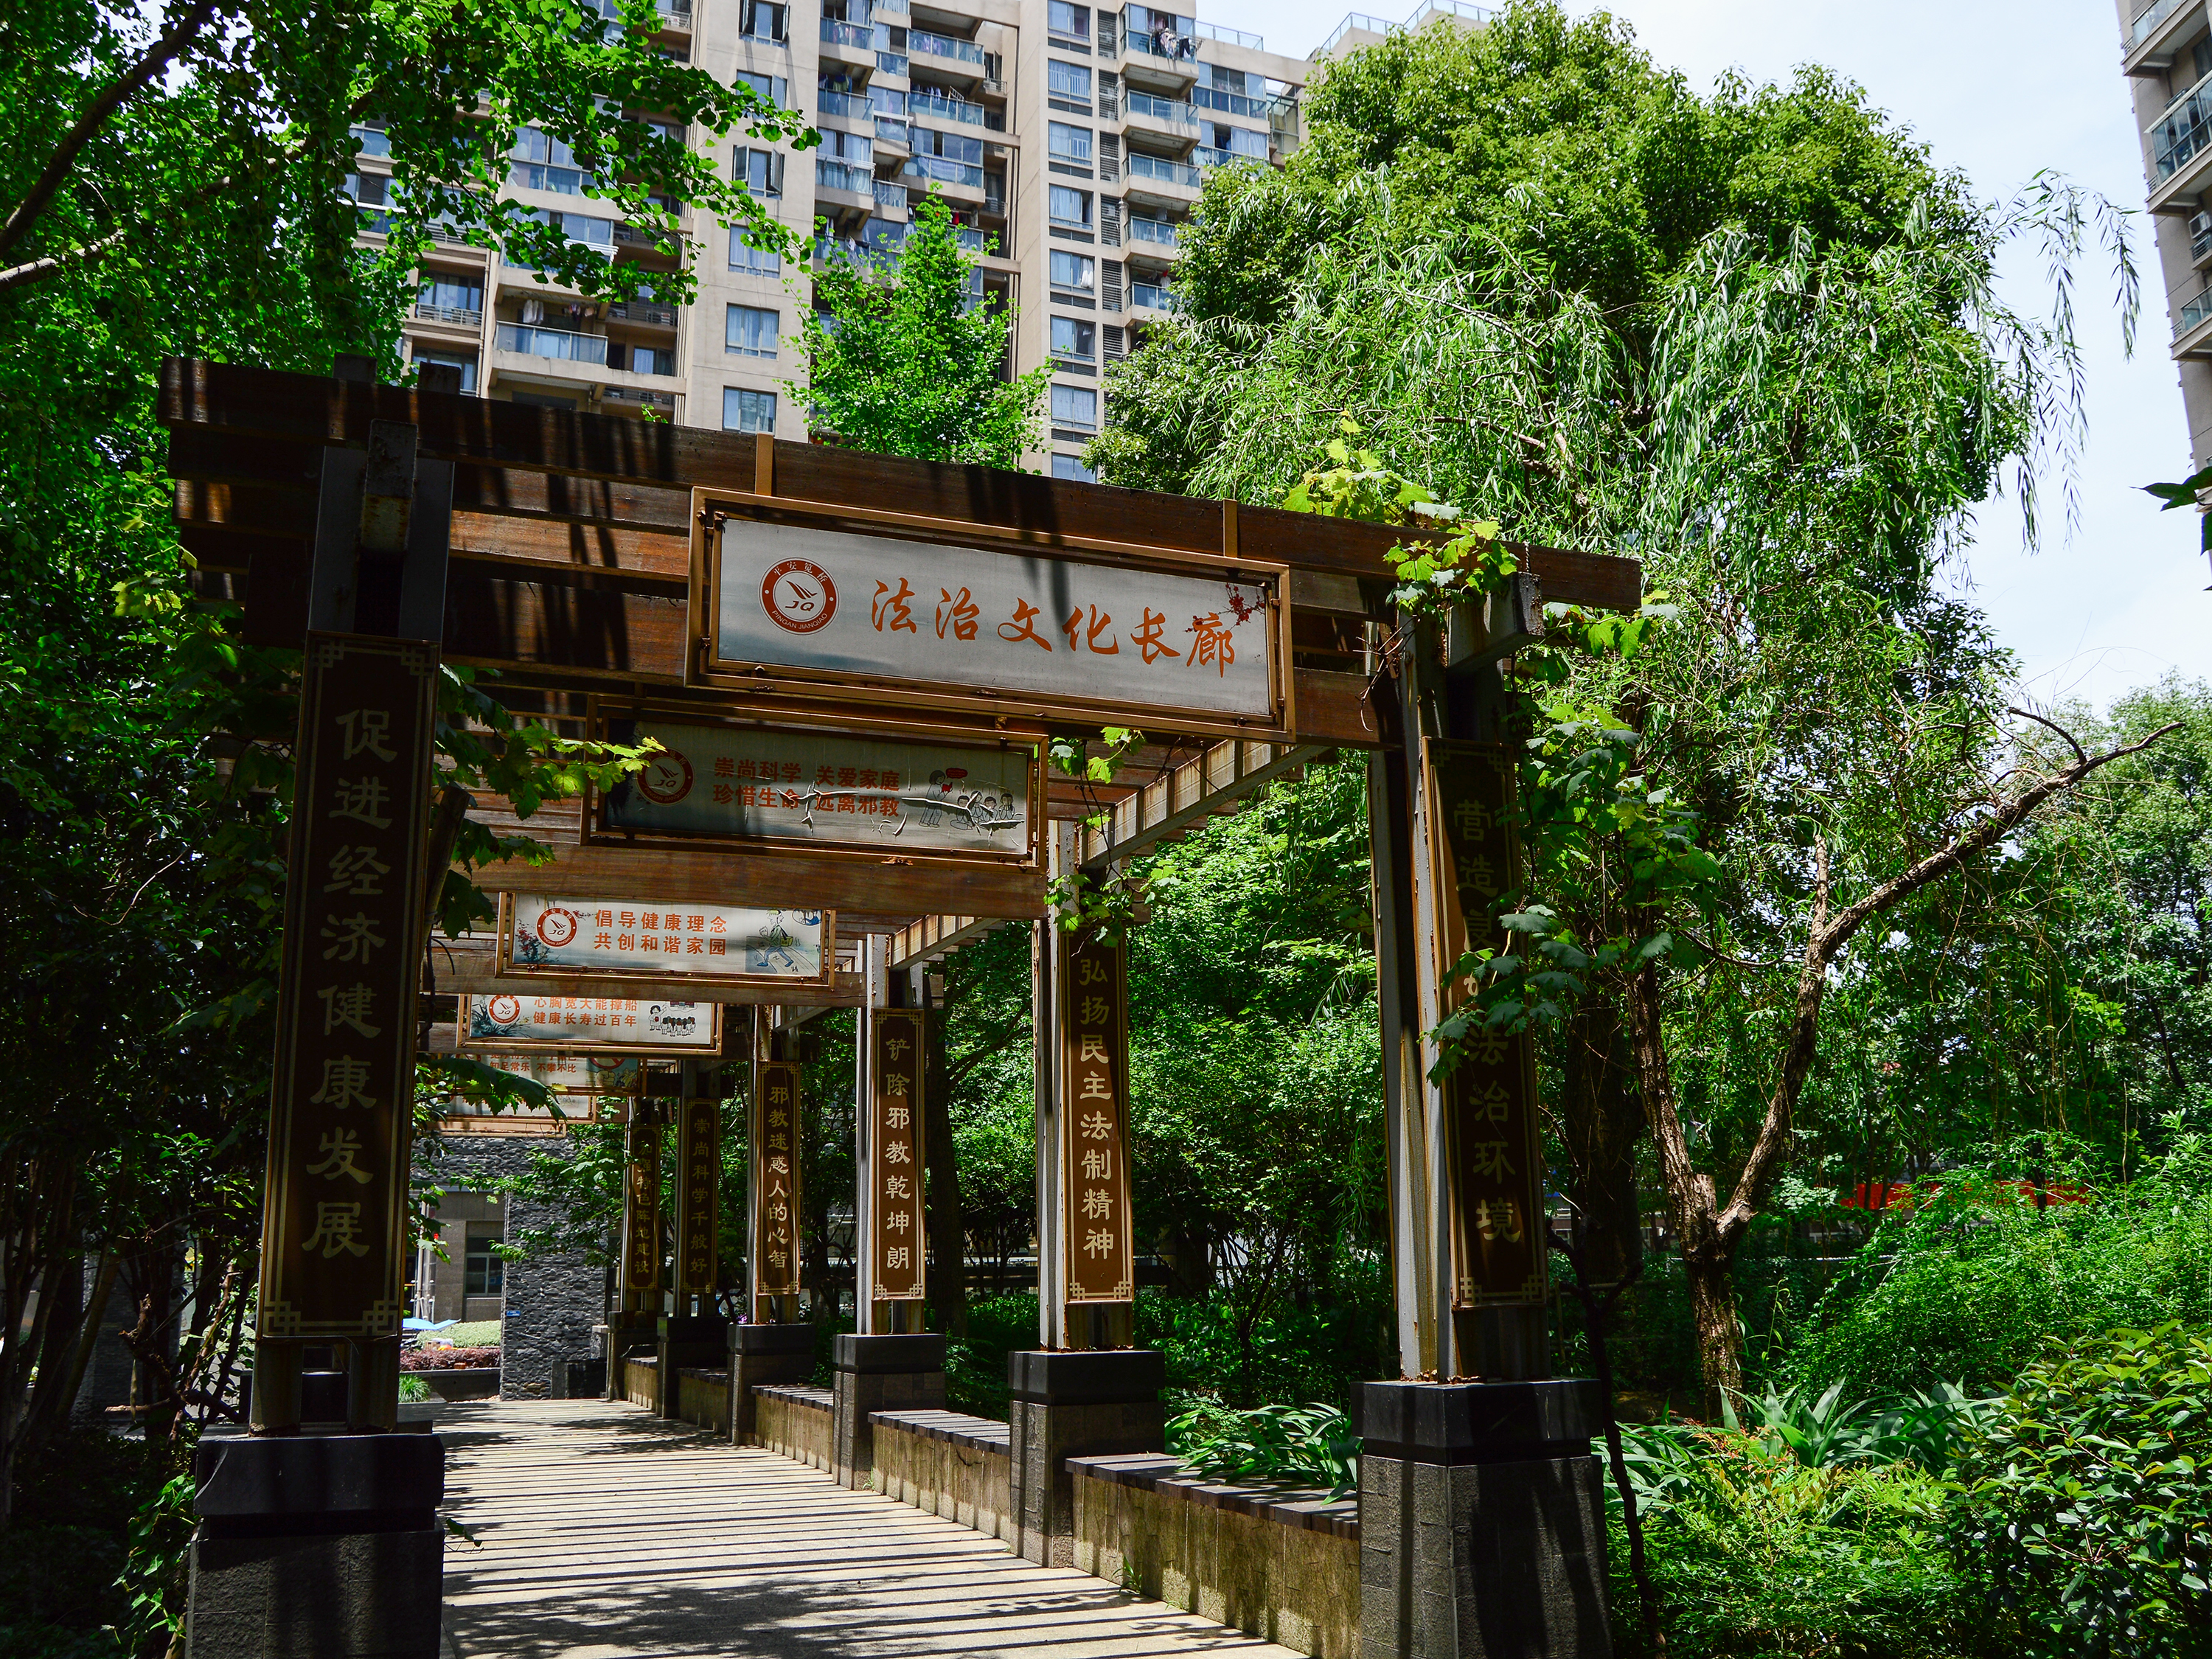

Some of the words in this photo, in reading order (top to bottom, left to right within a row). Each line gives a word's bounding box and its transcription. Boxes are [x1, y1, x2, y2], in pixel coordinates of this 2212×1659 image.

[771, 610, 797, 629] PINGAN
[798, 613, 827, 630] JIANQIAO
[785, 600, 815, 612] JQ
[871, 577, 1236, 678] 法治文化长廊
[654, 779, 677, 788] JQ
[714, 757, 802, 784] 崇尚科学
[815, 765, 900, 792] 关爱家庭
[712, 783, 799, 810] 珍惜生命
[814, 791, 900, 818] 远离邪教
[595, 909, 727, 933] 倡导健康理念
[594, 932, 726, 956] 共创和谐家园
[302, 708, 398, 1259] 促进经济健康发展
[532, 1011, 638, 1027] 健康长寿过百年
[534, 996, 638, 1012] 心胸宽大能撑船
[536, 1062, 577, 1073] 不攀不比
[1079, 959, 1115, 1260] 弘扬民主法制精神
[885, 1037, 911, 1270] 铲除邪教乾坤朗
[768, 1086, 790, 1269] 邪教迷惑人的心智
[634, 1141, 653, 1274] 加强特色阵地建设
[690, 1118, 710, 1274] 崇尚科学千般好
